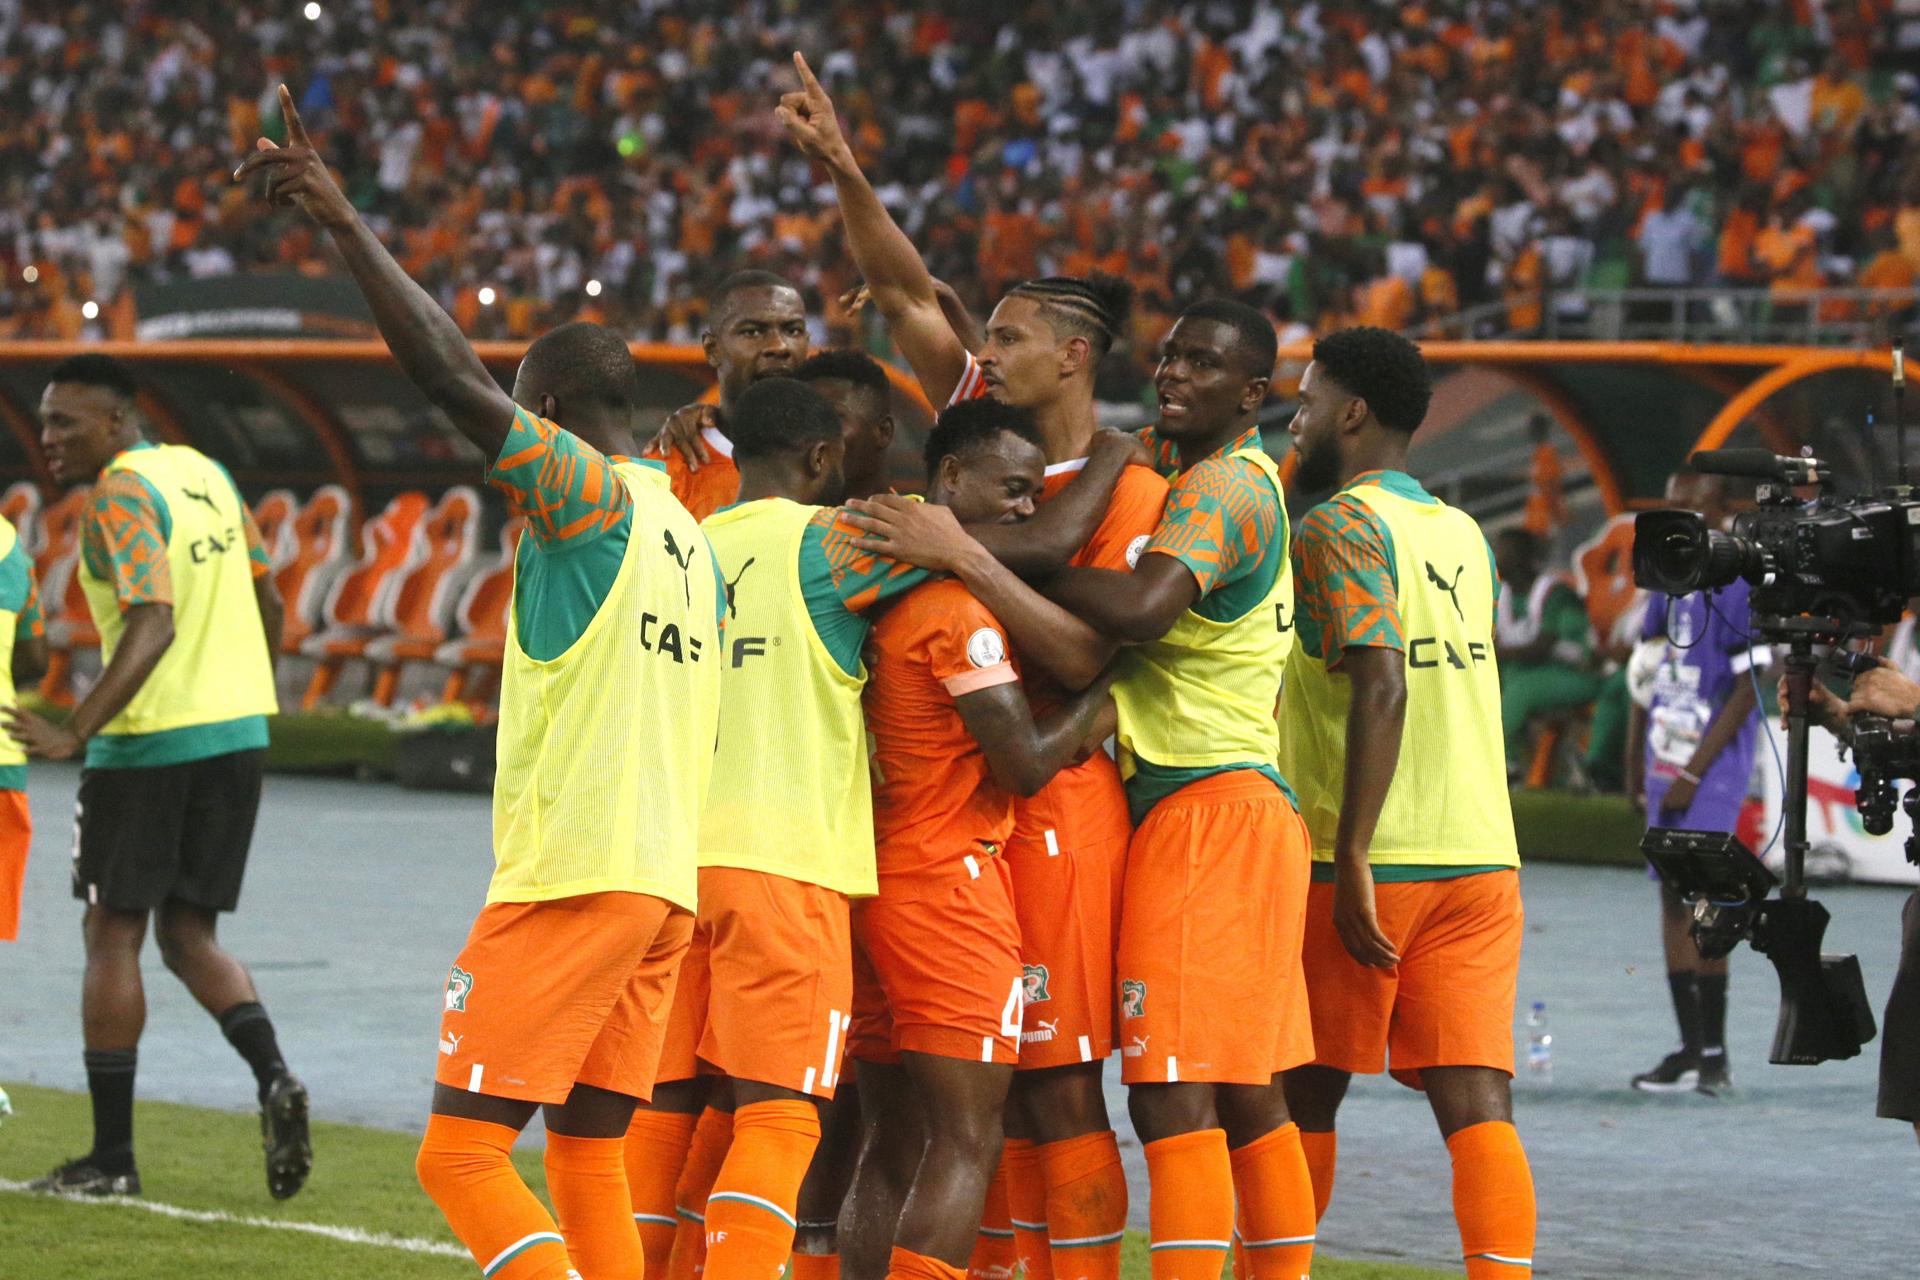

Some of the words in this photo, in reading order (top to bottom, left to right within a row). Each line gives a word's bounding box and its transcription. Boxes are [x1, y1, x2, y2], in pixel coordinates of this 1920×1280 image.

[1275, 603, 1295, 633] C
[1409, 637, 1486, 670] CAF
[1001, 976, 1024, 1055] 4
[821, 1009, 851, 1089] 1
[705, 1231, 728, 1248] IF
